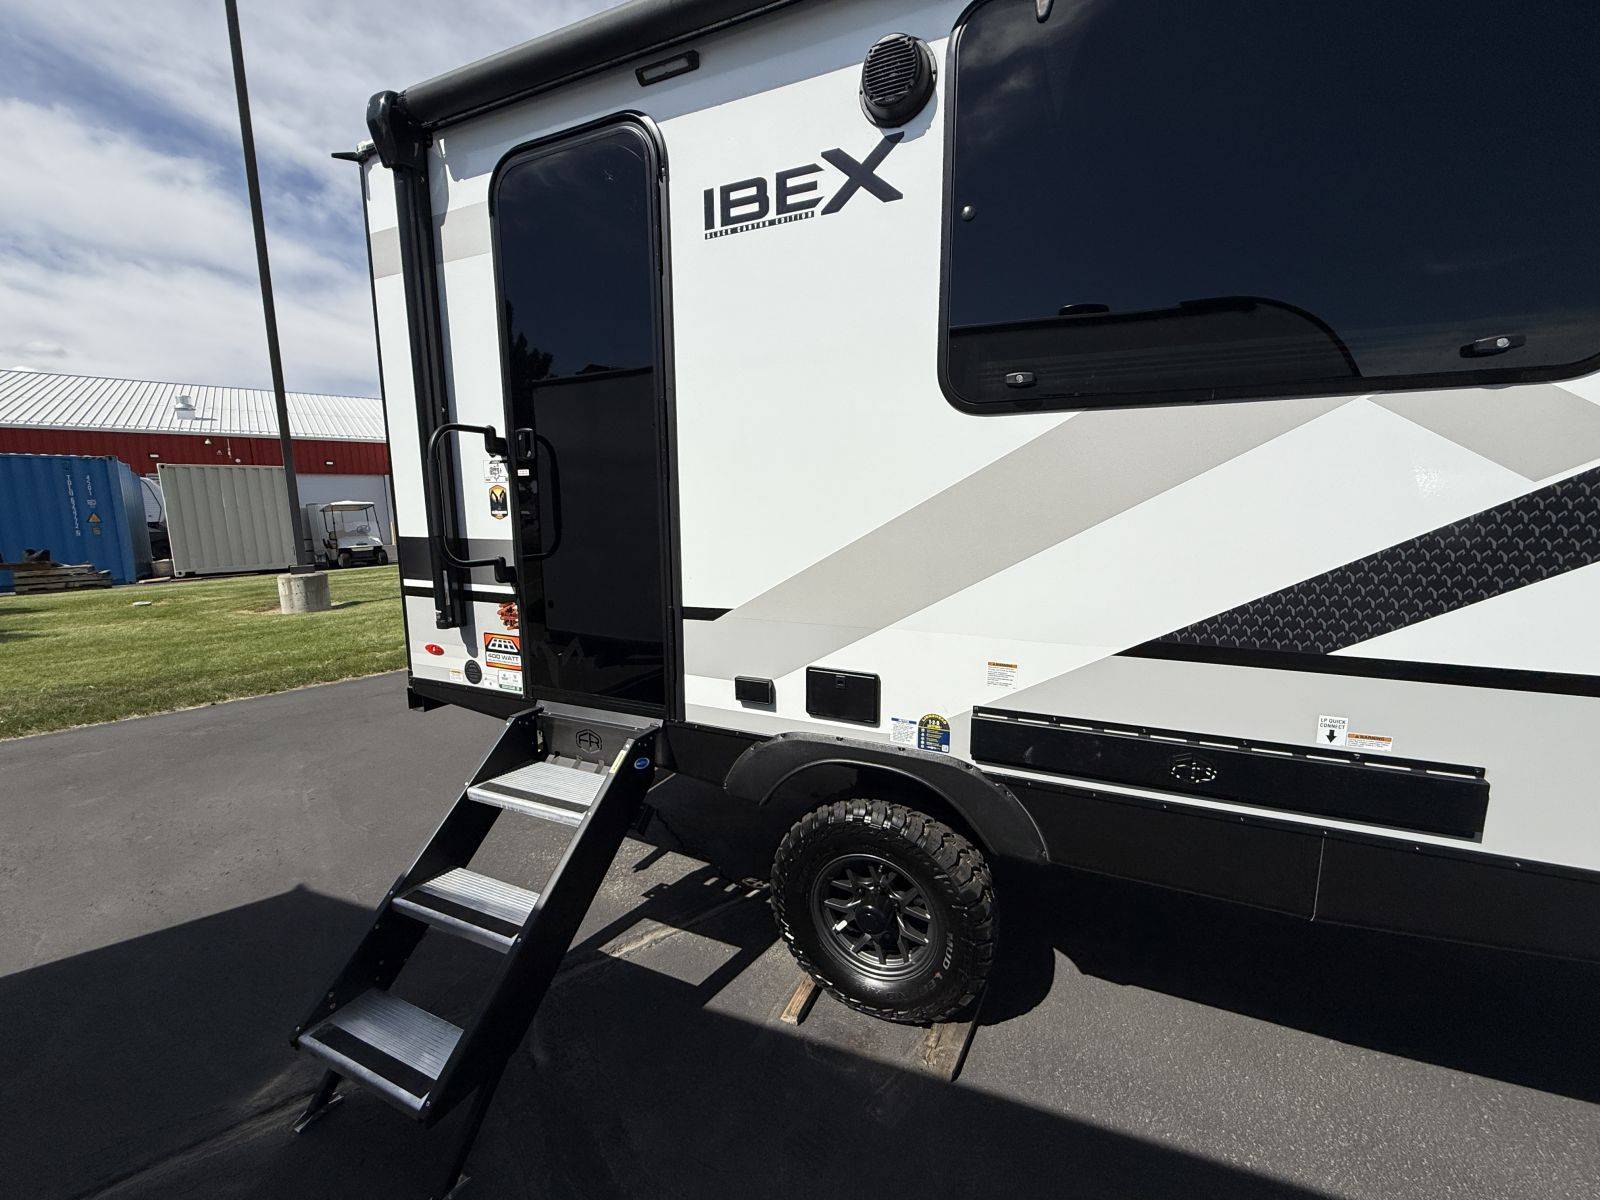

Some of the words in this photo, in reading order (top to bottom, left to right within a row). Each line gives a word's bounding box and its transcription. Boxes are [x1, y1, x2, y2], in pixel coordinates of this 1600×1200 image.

[704, 131, 905, 231] IBEX
[488, 653, 501, 661] 400
[501, 654, 520, 663] WATT
